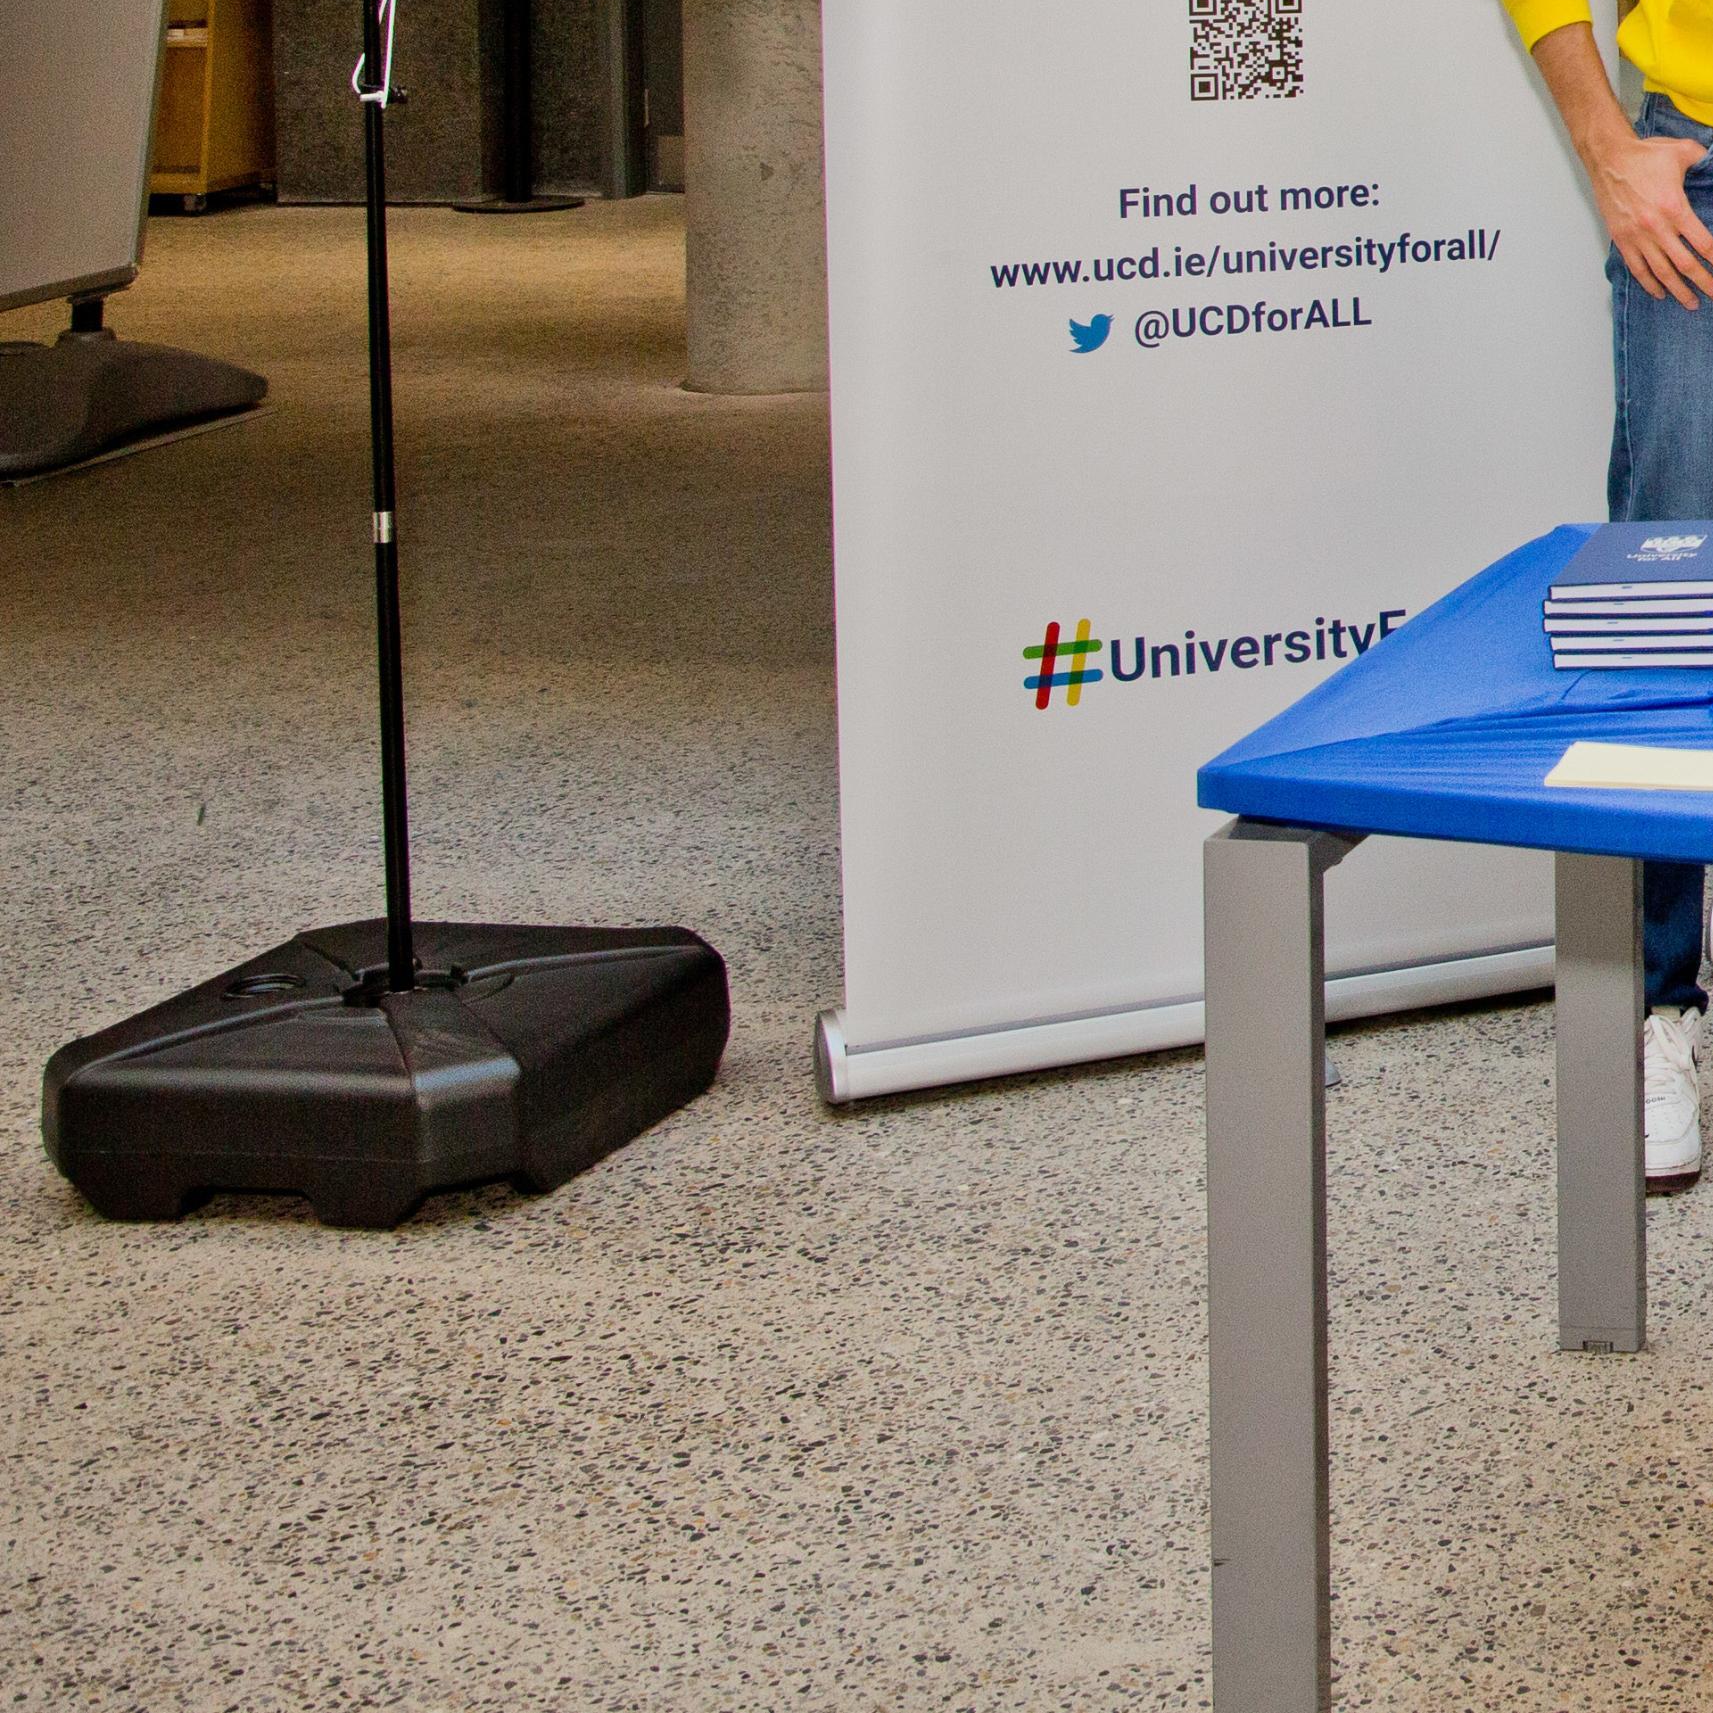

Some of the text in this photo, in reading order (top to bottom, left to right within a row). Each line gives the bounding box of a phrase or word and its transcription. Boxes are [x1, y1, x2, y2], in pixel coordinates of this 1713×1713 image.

[1119, 179, 1381, 220] Find out more:
[991, 229, 1501, 289] www.ucd.ie/universityforall/
[1134, 296, 1372, 349] @UCDforALL
